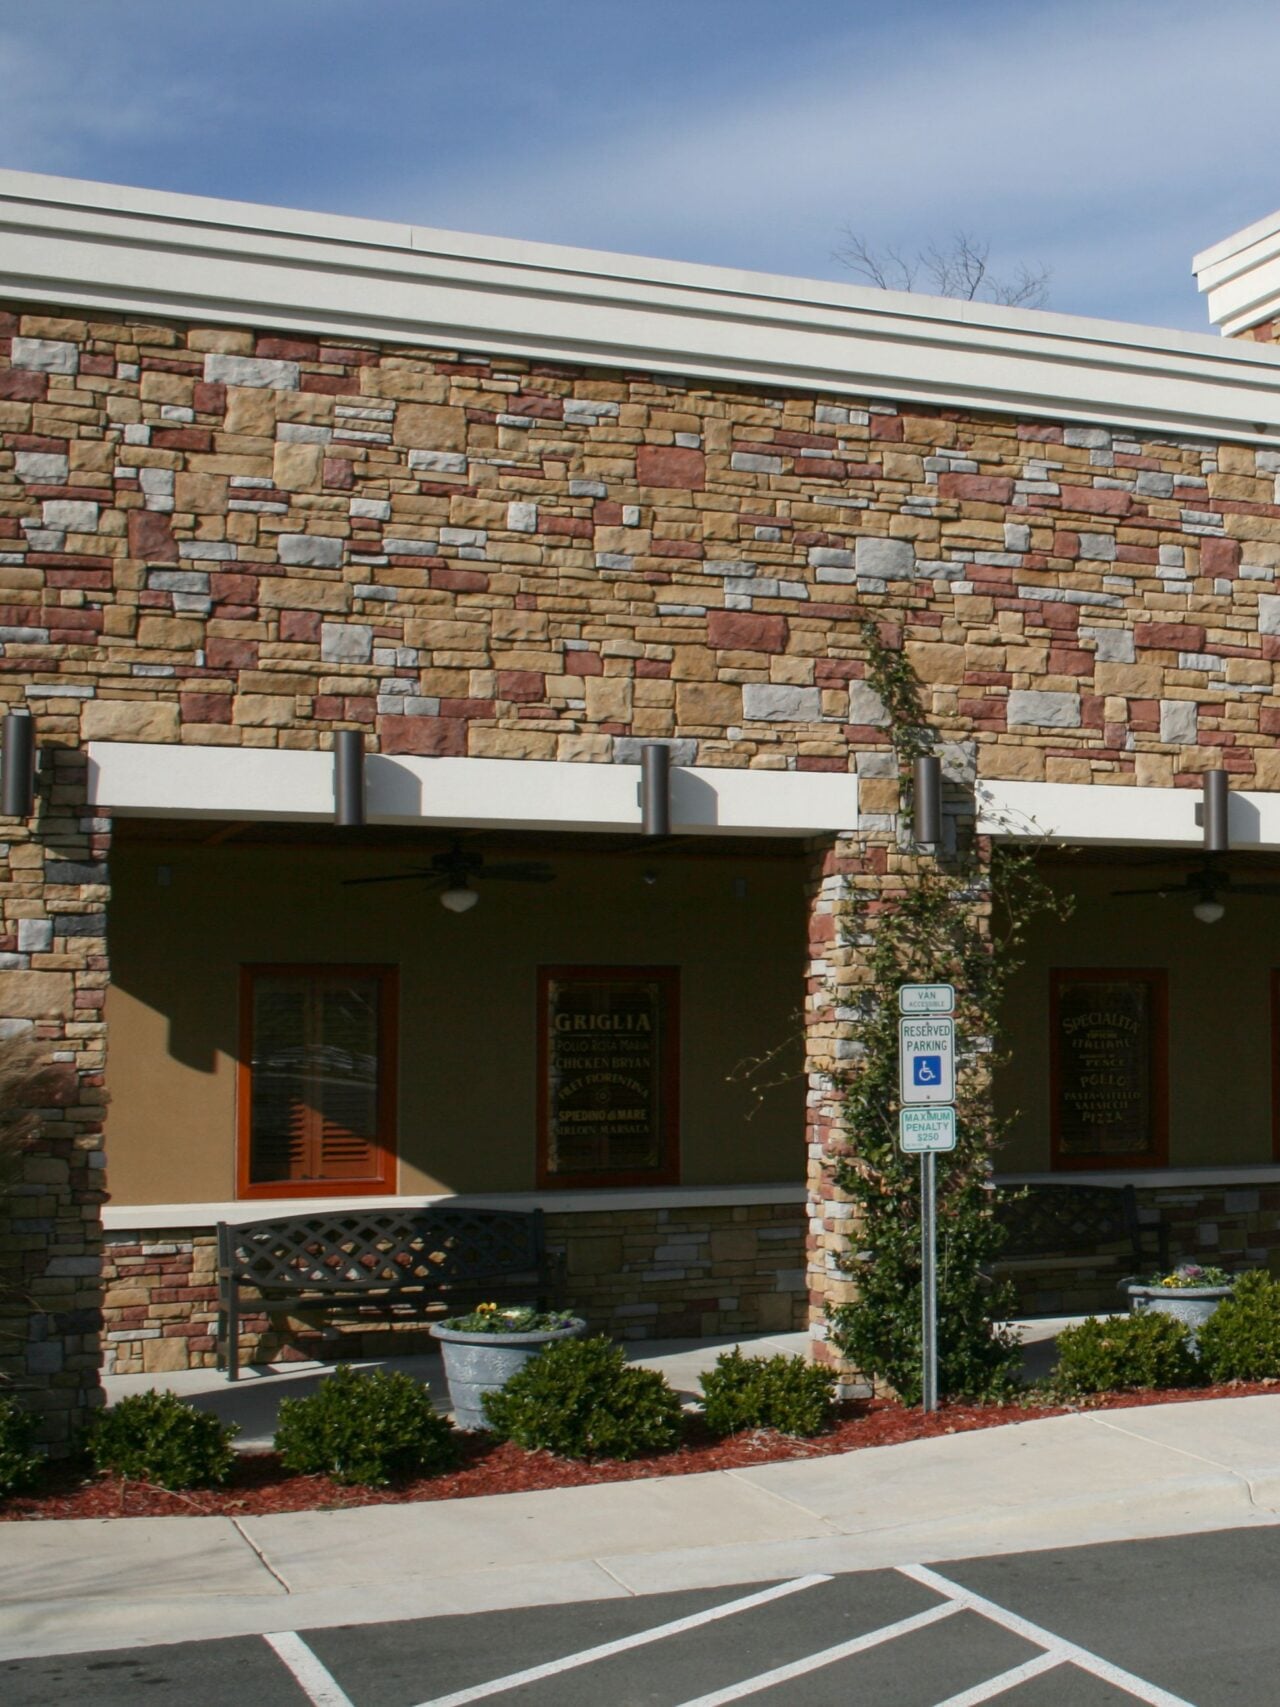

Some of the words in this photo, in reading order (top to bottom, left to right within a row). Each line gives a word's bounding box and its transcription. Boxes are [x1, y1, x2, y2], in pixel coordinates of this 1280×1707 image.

[918, 991, 936, 1000] VAN
[908, 1000, 945, 1008] ACCESSIBLE
[555, 1012, 652, 1032] GRIGLIA
[903, 1025, 950, 1037] RESERVED
[906, 1040, 947, 1051] PARKING
[556, 1057, 610, 1069] CHICKEN
[612, 1056, 651, 1069] BRYAN
[558, 1109, 606, 1122] SPIEDINO
[617, 1109, 648, 1121] MARE
[905, 1112, 950, 1122] MAXIMUM
[906, 1122, 949, 1132] PENALTY
[917, 1132, 940, 1142] $250
